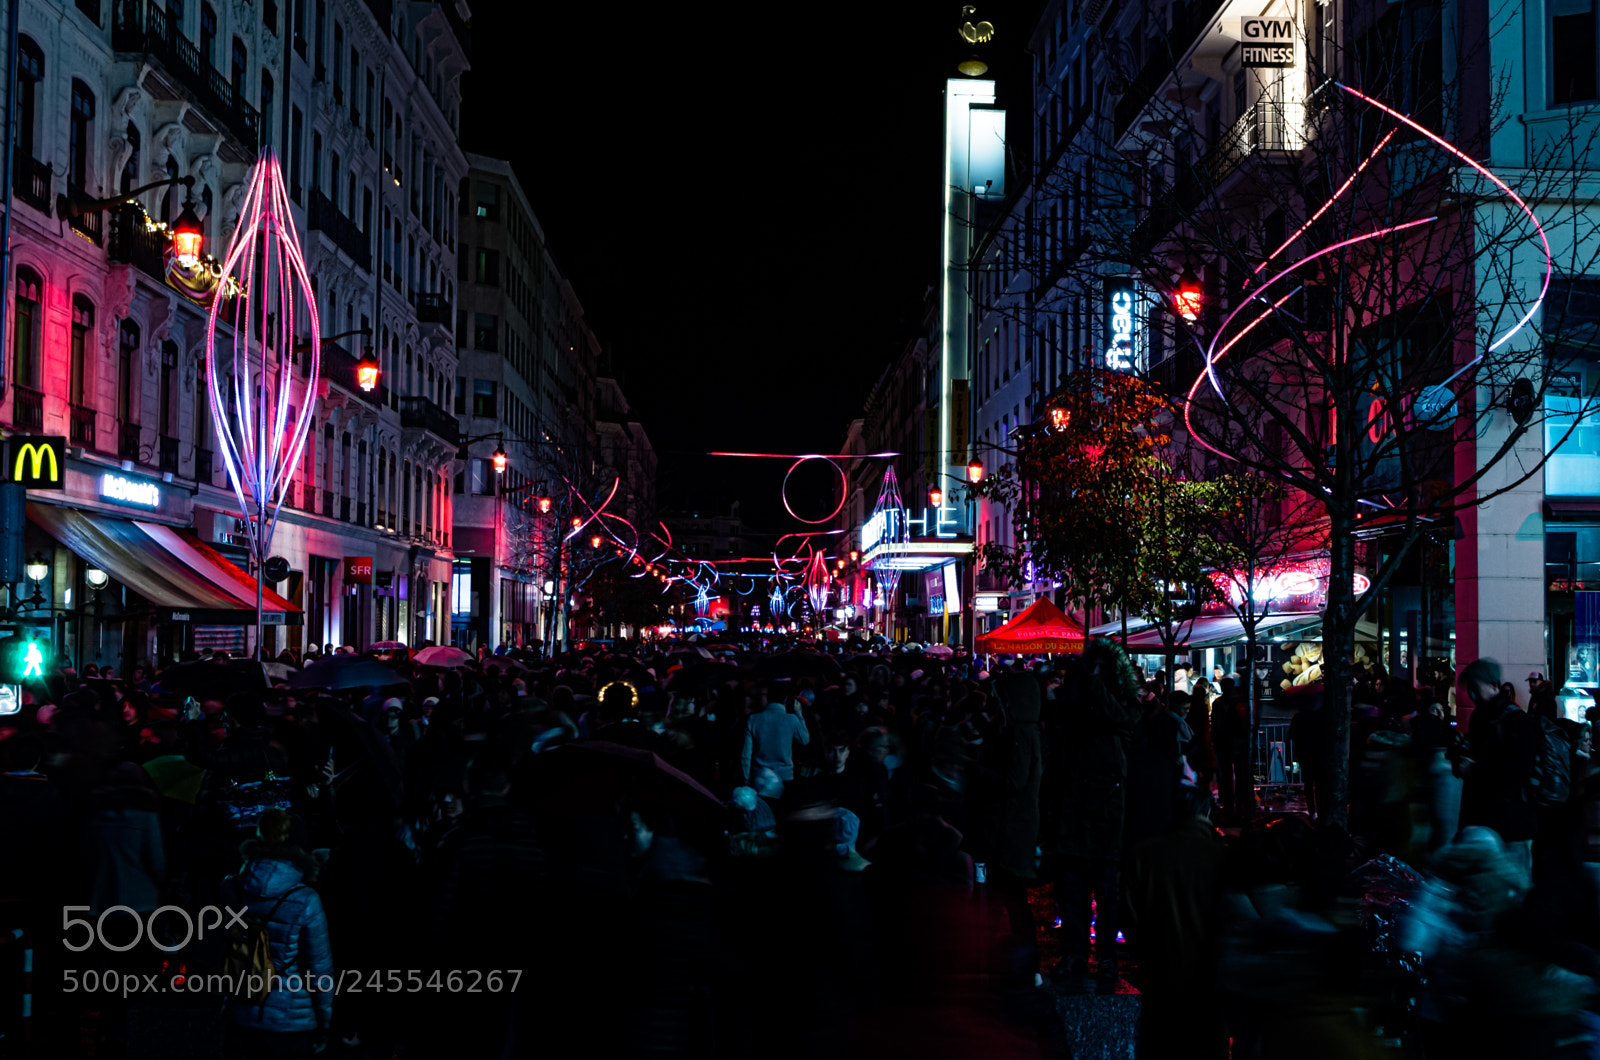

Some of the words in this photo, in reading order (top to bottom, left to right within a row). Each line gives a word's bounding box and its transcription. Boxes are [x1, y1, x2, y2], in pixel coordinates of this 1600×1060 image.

[1243, 20, 1292, 38] GYM
[1242, 47, 1294, 63] FITNESS
[1105, 292, 1132, 370] fnac
[350, 565, 371, 575] SFR
